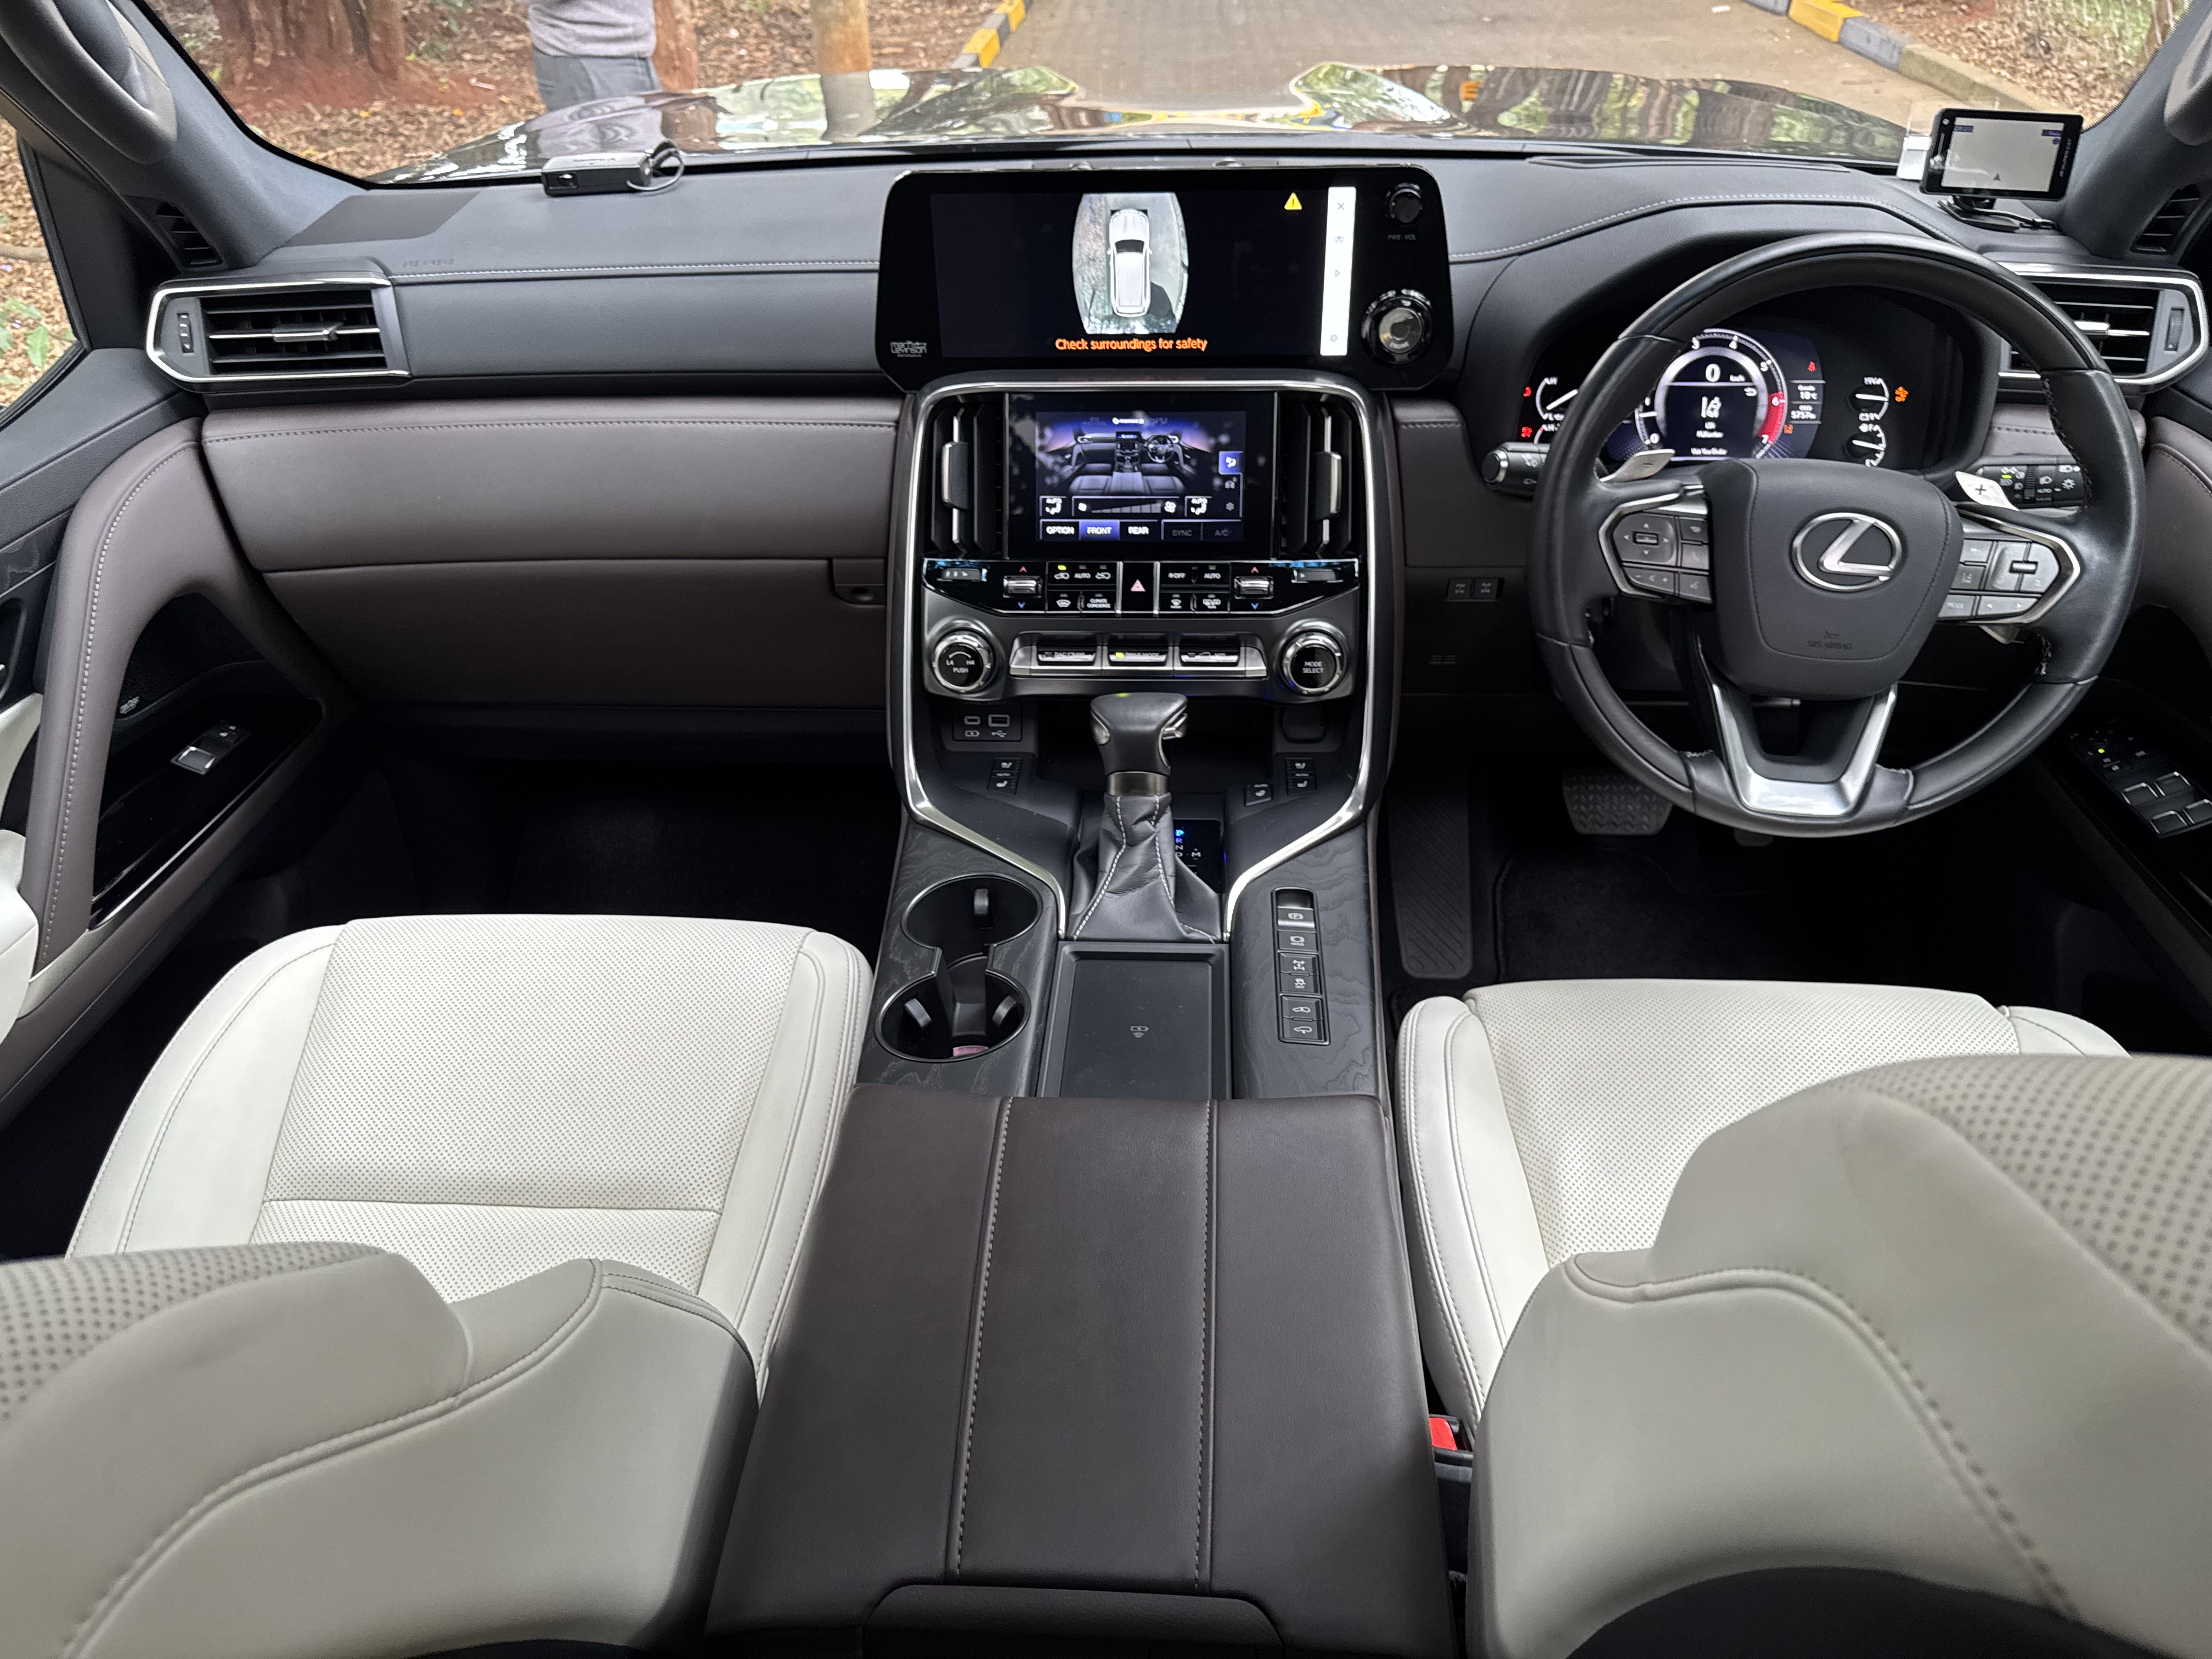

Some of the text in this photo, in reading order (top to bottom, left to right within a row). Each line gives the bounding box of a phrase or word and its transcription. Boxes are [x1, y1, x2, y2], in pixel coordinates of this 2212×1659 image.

[1055, 337, 1207, 352] Check surroundings for safety
[1760, 361, 1769, 372] 5
[1705, 363, 1720, 382] 0
[1771, 396, 1780, 406] 6
[1650, 433, 1660, 444] 0
[1761, 434, 1769, 444] 7
[1046, 526, 1074, 534] OPTION
[1087, 526, 1112, 534] FRONT
[1128, 526, 1149, 534] REAR
